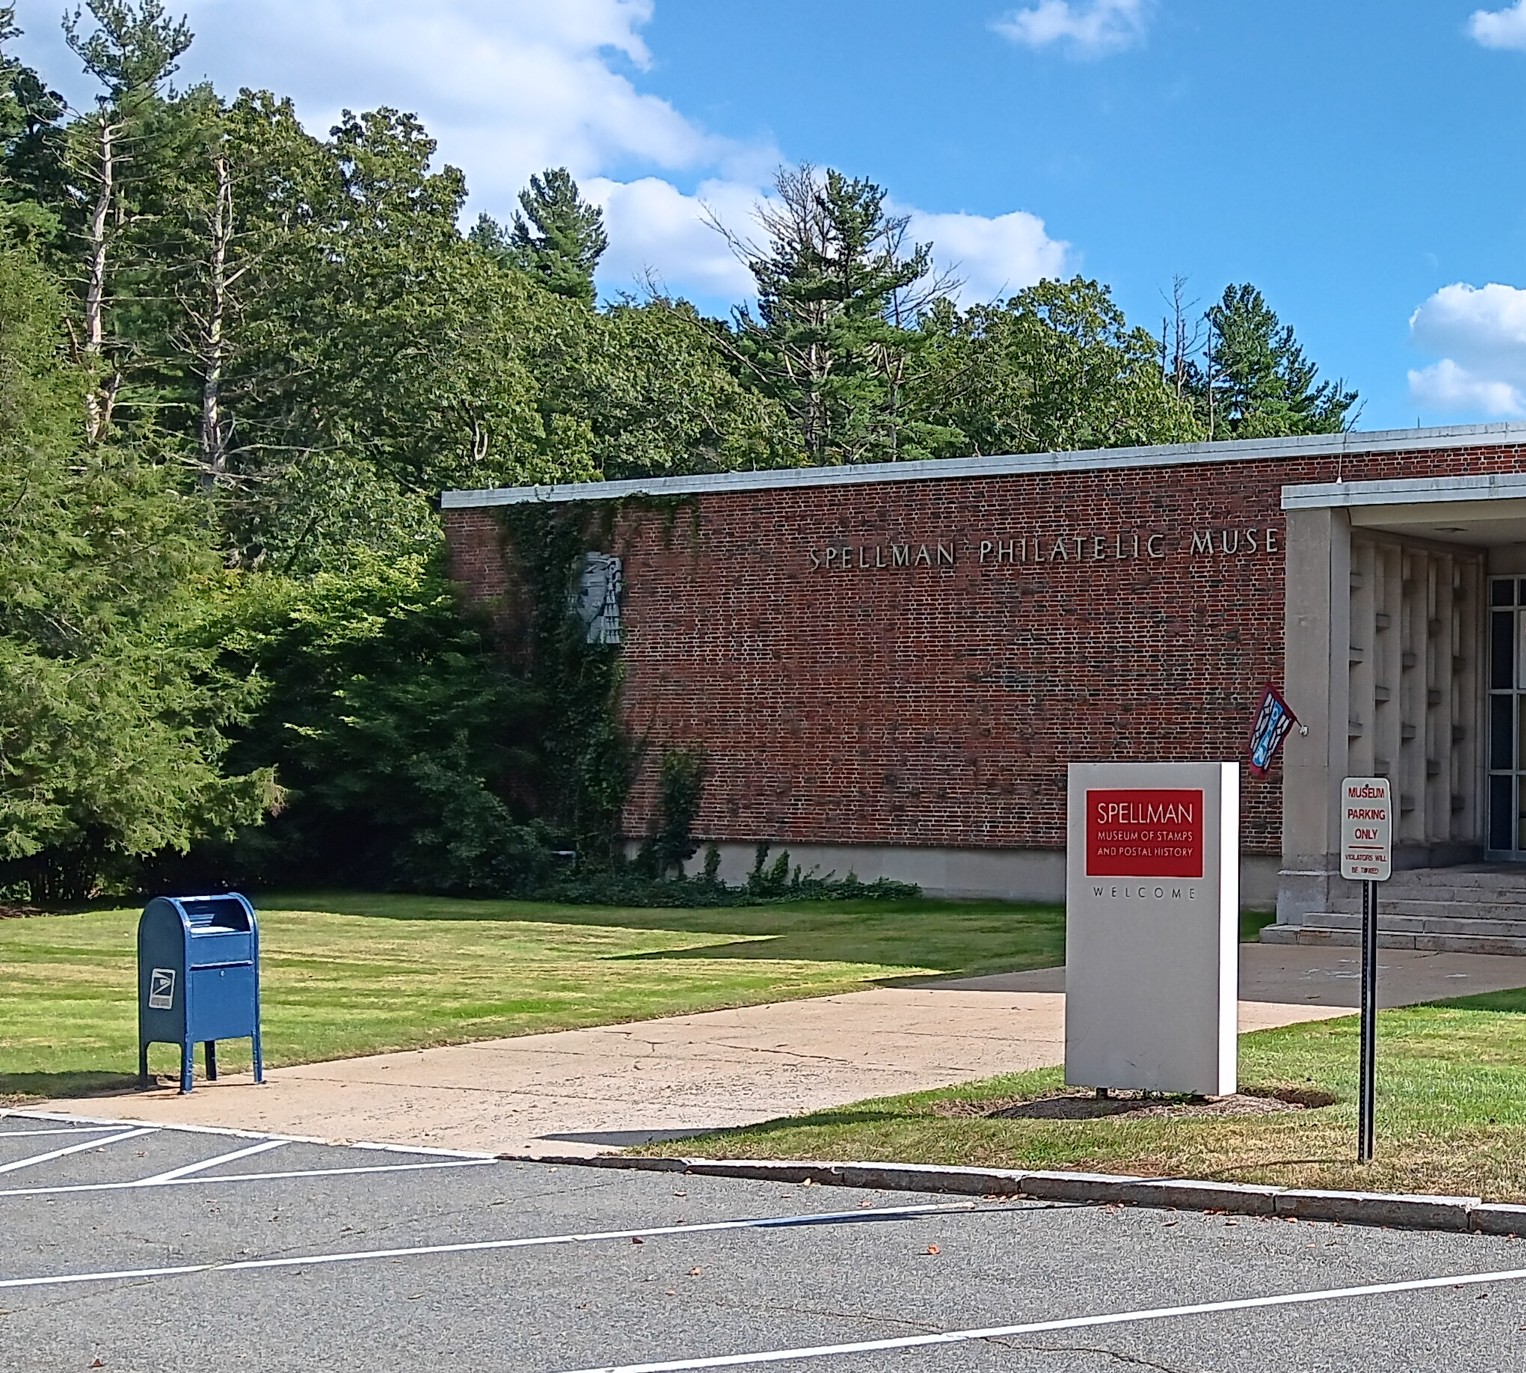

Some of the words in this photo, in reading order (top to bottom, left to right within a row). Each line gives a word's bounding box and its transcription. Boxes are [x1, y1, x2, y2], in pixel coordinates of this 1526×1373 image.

[809, 541, 955, 571] SPELLMAN
[979, 533, 1165, 563] PHILATELIC
[1348, 787, 1385, 799] MUSEUM
[1097, 802, 1193, 824] SPELLMAN
[1347, 808, 1386, 820] PARKING
[1097, 830, 1138, 841] MUSEUM
[1140, 830, 1155, 841] OF
[1157, 830, 1193, 842] STAMPS
[1354, 828, 1378, 840] ONLY
[1097, 847, 1117, 856] AND
[1119, 847, 1151, 857] POSTAL
[1154, 847, 1193, 857] HISTORY
[1344, 854, 1373, 862] VIOLATORS
[1093, 886, 1195, 899] WELCOME
